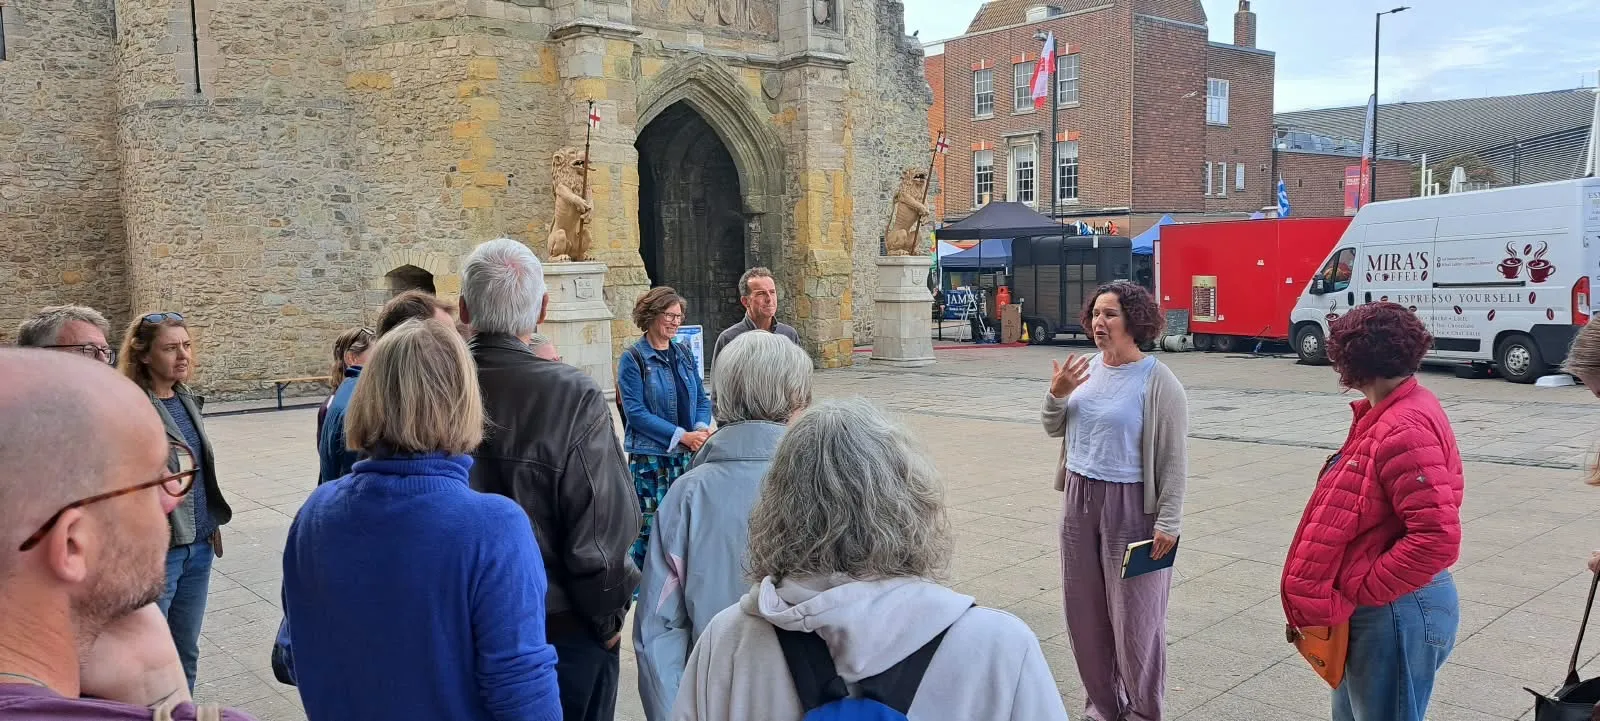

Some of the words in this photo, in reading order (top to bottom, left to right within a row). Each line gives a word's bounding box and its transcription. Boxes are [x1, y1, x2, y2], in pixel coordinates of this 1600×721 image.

[1366, 251, 1429, 271] MIRA'S
[1397, 293, 1452, 303] ESPRESSO
[1459, 292, 1522, 303] YOURSELF
